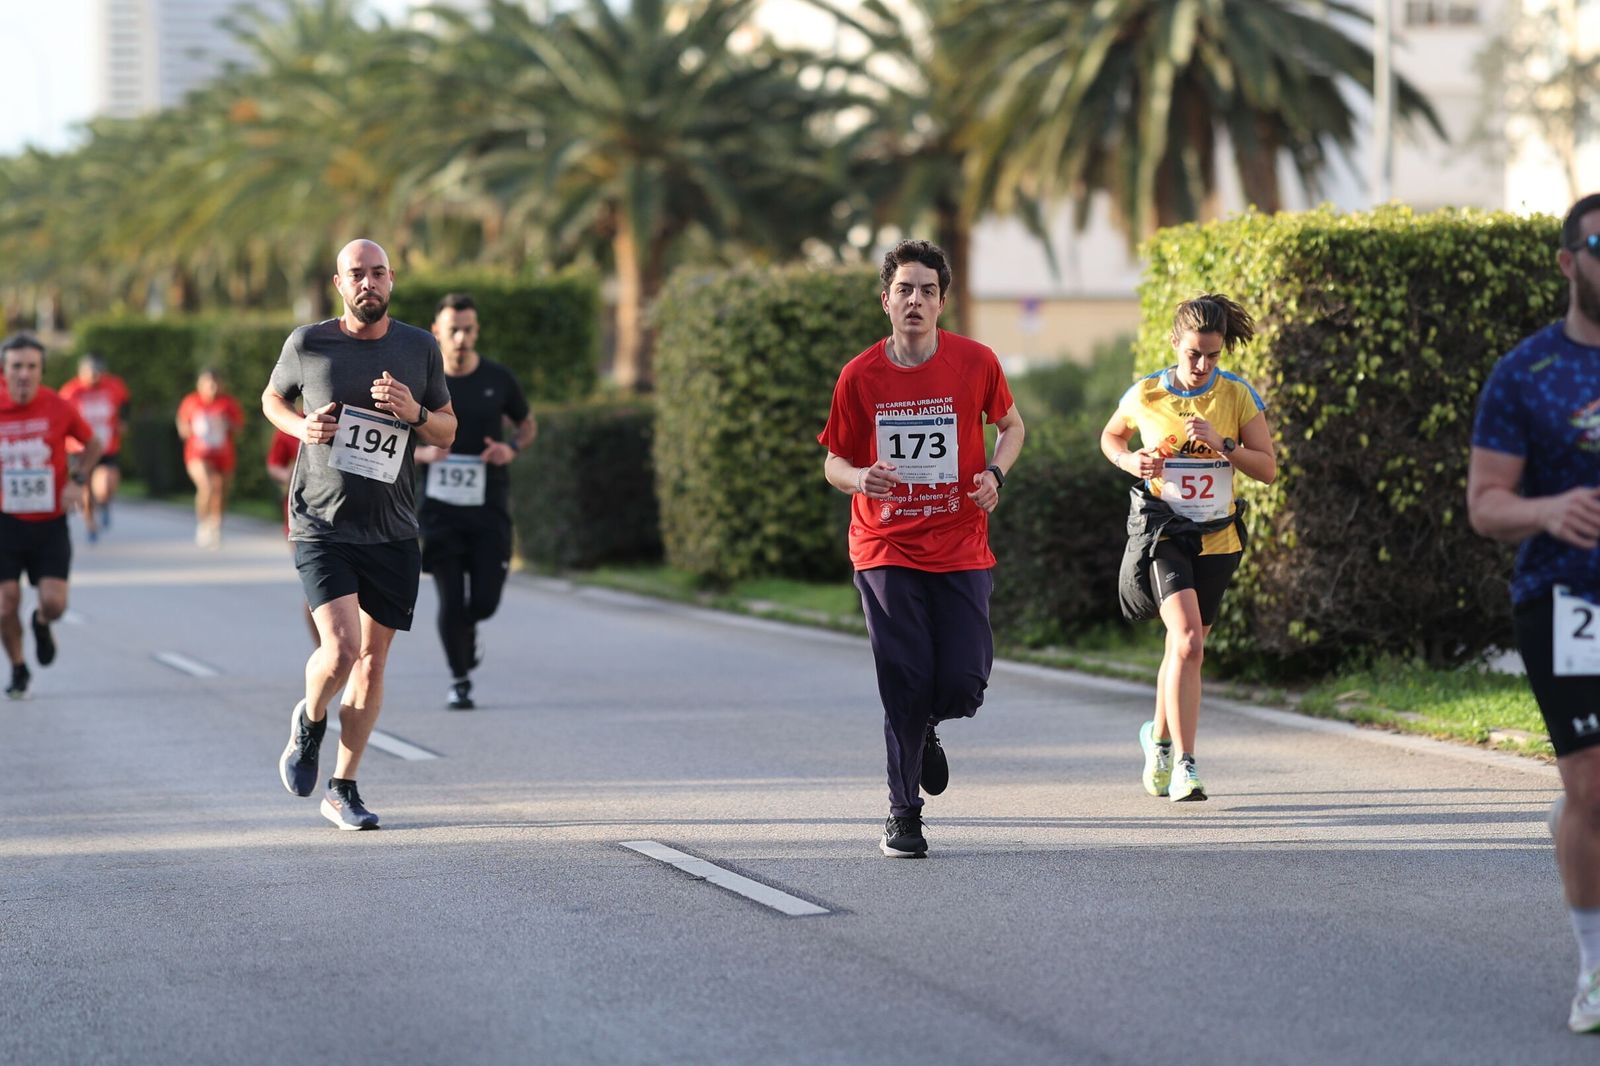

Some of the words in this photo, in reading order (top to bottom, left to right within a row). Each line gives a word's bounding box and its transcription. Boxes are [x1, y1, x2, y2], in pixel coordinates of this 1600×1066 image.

[876, 408, 914, 417] CIUDAD
[916, 403, 953, 415] JARDÍN
[885, 400, 916, 408] CARRERA
[917, 397, 944, 406] URBANA
[345, 424, 398, 459] 194
[889, 432, 947, 459] 173
[11, 478, 47, 498] 158
[439, 468, 477, 488] 192
[1181, 474, 1215, 500] 52
[1572, 607, 1595, 639] 2
